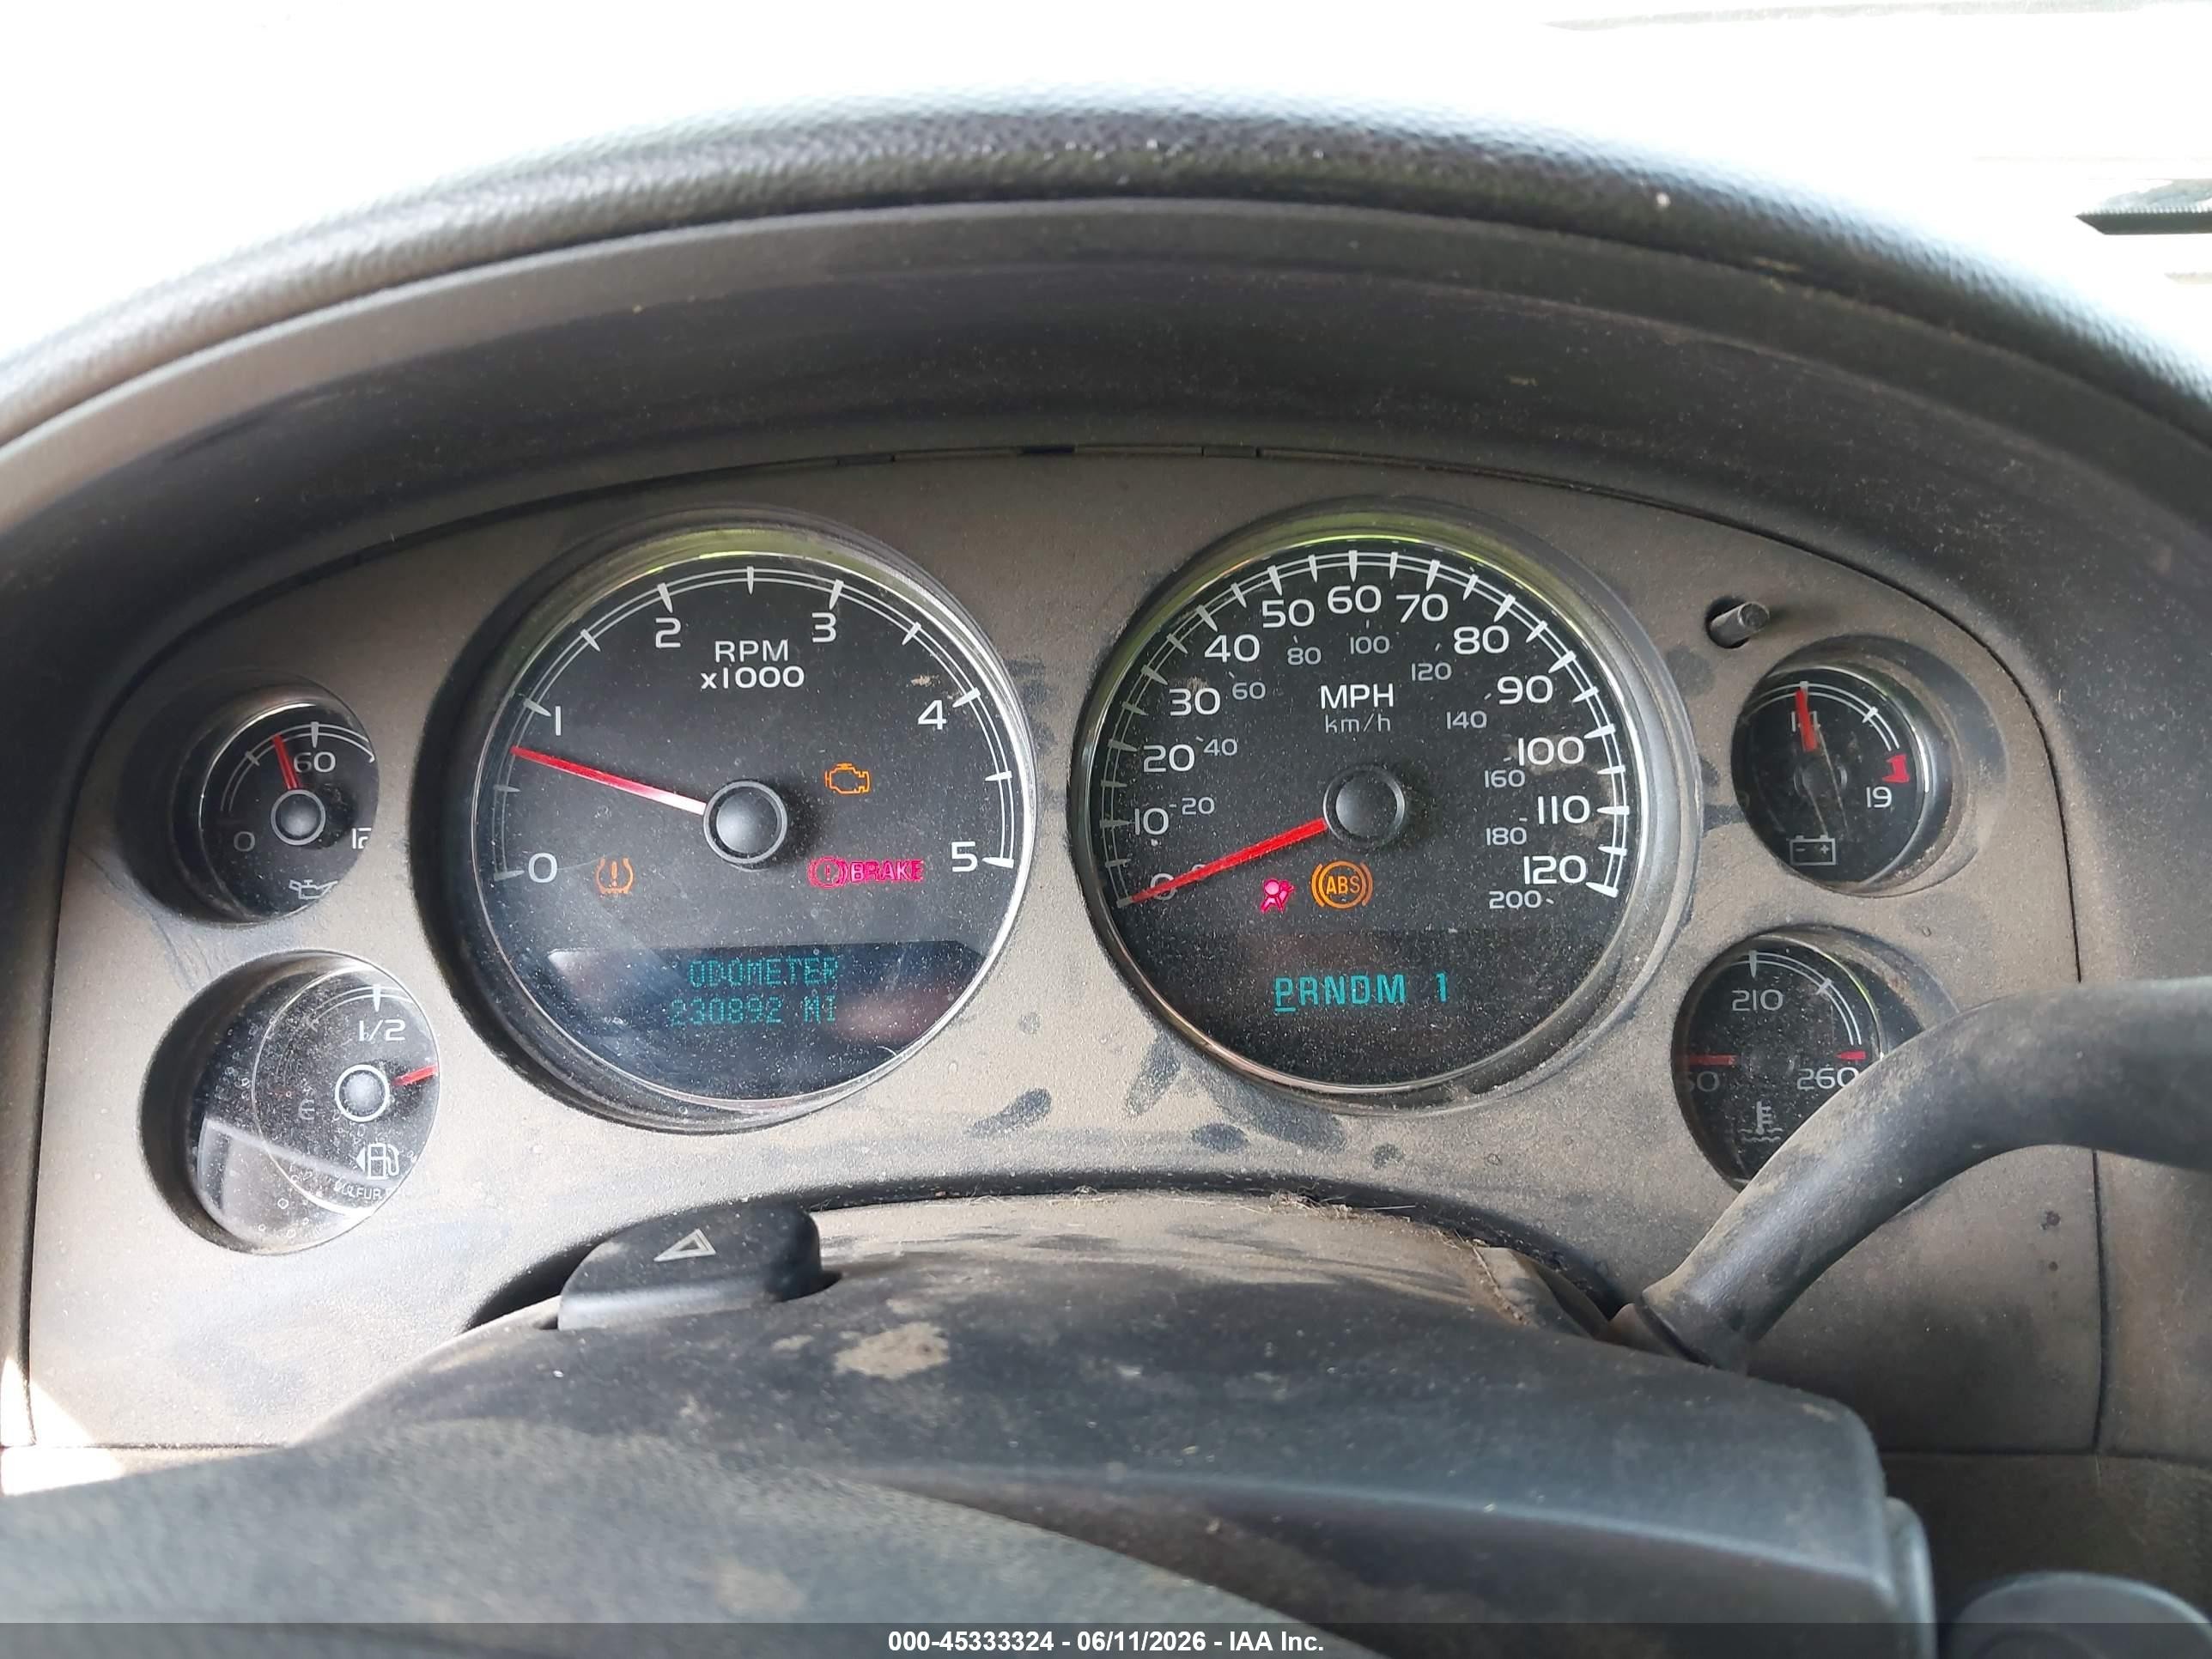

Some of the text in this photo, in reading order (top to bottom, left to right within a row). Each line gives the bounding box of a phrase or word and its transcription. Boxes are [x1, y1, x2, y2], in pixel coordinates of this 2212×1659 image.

[1327, 586, 1382, 614] 60
[1395, 593, 1449, 623] 70
[1261, 599, 1316, 628] 50
[654, 617, 682, 649] 2
[811, 612, 837, 643] 3
[1453, 625, 1510, 653] 80
[714, 639, 789, 664] RPM
[1204, 634, 1261, 663] 40
[1286, 647, 1322, 665] 80
[1348, 636, 1390, 653] 100
[700, 666, 805, 690] x1000
[1411, 663, 1452, 681] 120
[1170, 687, 1220, 715] 30
[1231, 682, 1267, 699] 60
[1321, 684, 1395, 708] MPH
[1497, 675, 1553, 704] 90
[554, 706, 562, 736] 1
[918, 701, 947, 730] 4
[1324, 714, 1392, 732] km/h
[1446, 710, 1487, 729] 140
[1142, 744, 1195, 772] 20
[1203, 738, 1238, 757] 40
[1517, 738, 1584, 766] 100
[294, 751, 337, 772] 60
[1484, 769, 1526, 787] 160
[1182, 797, 1215, 815] 20
[1537, 795, 1591, 823] 110
[1866, 787, 1893, 808] 19
[1134, 808, 1170, 836] 10
[234, 831, 255, 852] 0
[1486, 826, 1528, 845] 180
[528, 854, 558, 884] 0
[951, 842, 977, 872] 5
[1523, 855, 1587, 884] 120
[850, 860, 923, 882] BRAKE
[1327, 876, 1361, 895] ABS
[1488, 890, 1542, 908] 200
[690, 957, 838, 987] ODOMETER
[1274, 972, 1449, 1012] PRNDM 1
[1732, 990, 1784, 1012] 210
[672, 995, 836, 1025] 230892 MI
[358, 1019, 406, 1042] 1/2
[1797, 1067, 1859, 1090] 260
